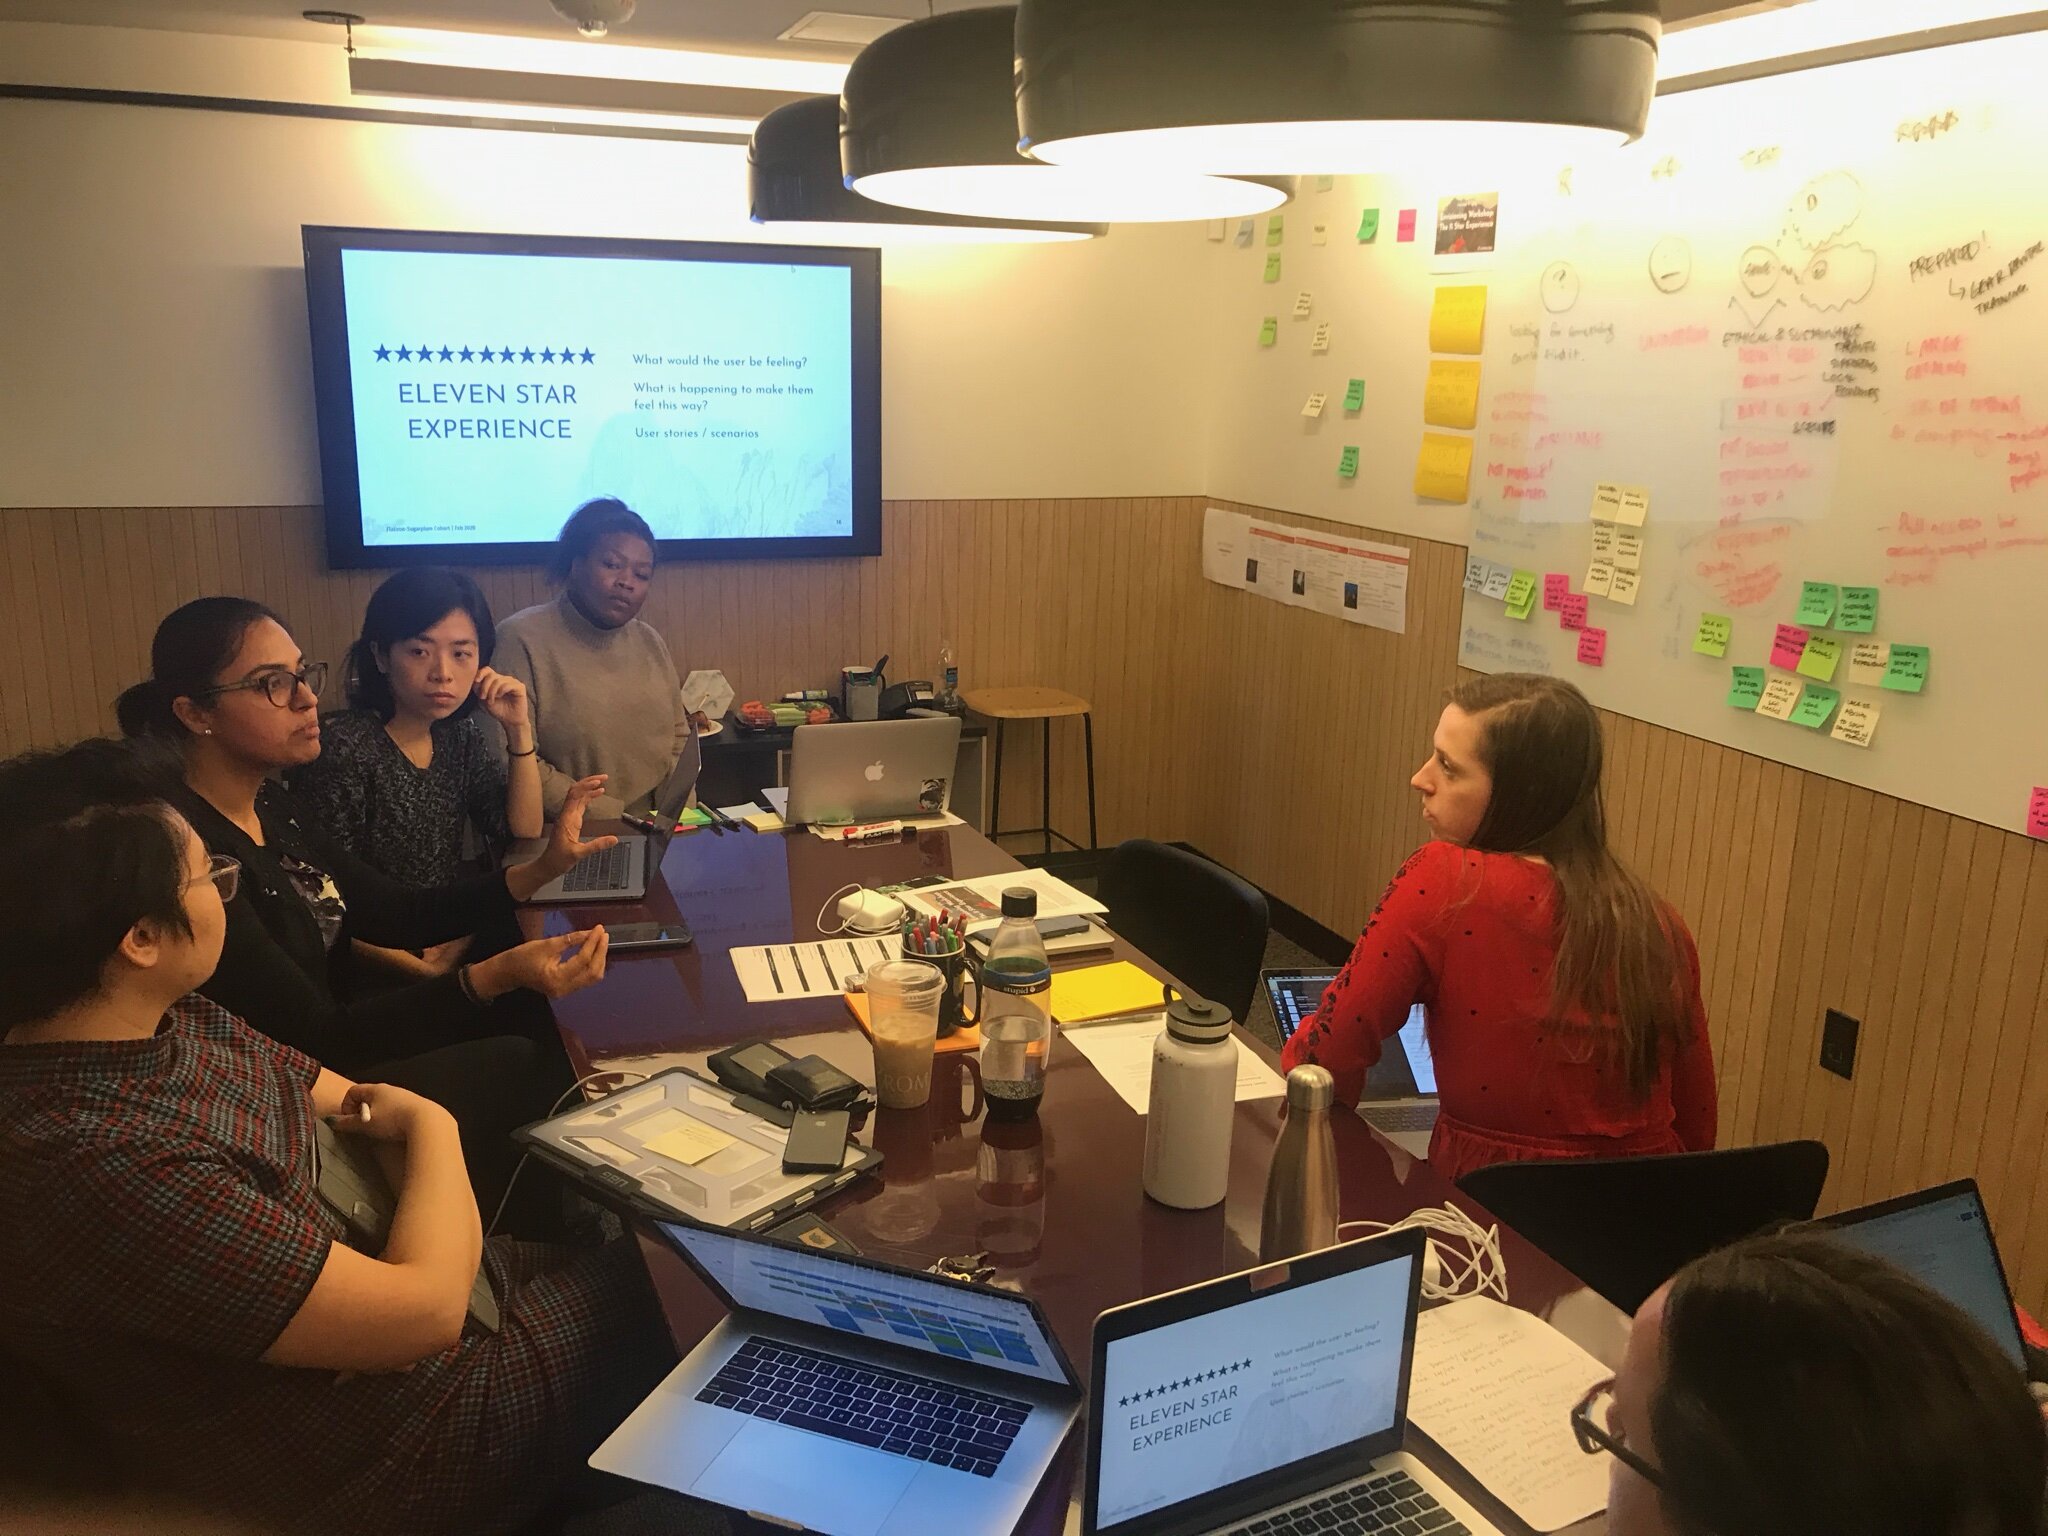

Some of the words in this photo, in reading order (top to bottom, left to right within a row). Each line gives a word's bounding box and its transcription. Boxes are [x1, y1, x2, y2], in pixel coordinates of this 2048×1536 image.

[633, 354, 663, 365] What
[667, 355, 699, 366] would
[703, 355, 720, 366] the
[724, 358, 745, 367] user
[750, 356, 762, 367] be
[766, 356, 808, 370] feeling?
[399, 383, 506, 404] ELEVEN
[516, 384, 577, 404] STAR
[633, 382, 664, 393] What
[668, 384, 676, 393] is
[680, 382, 737, 396] happening
[741, 385, 752, 394] to
[755, 384, 784, 395] make
[788, 384, 814, 395] them
[634, 399, 655, 410] feel
[658, 400, 677, 410] this
[681, 400, 708, 412] way?
[408, 419, 572, 439] EXPERIENCE
[635, 427, 659, 438] User
[664, 428, 698, 438] stories
[711, 429, 759, 439] scenarios
[1129, 1397, 1196, 1430] ELEVEN
[1200, 1384, 1239, 1408] STAR
[1132, 1407, 1233, 1451] EXPERIENCE
